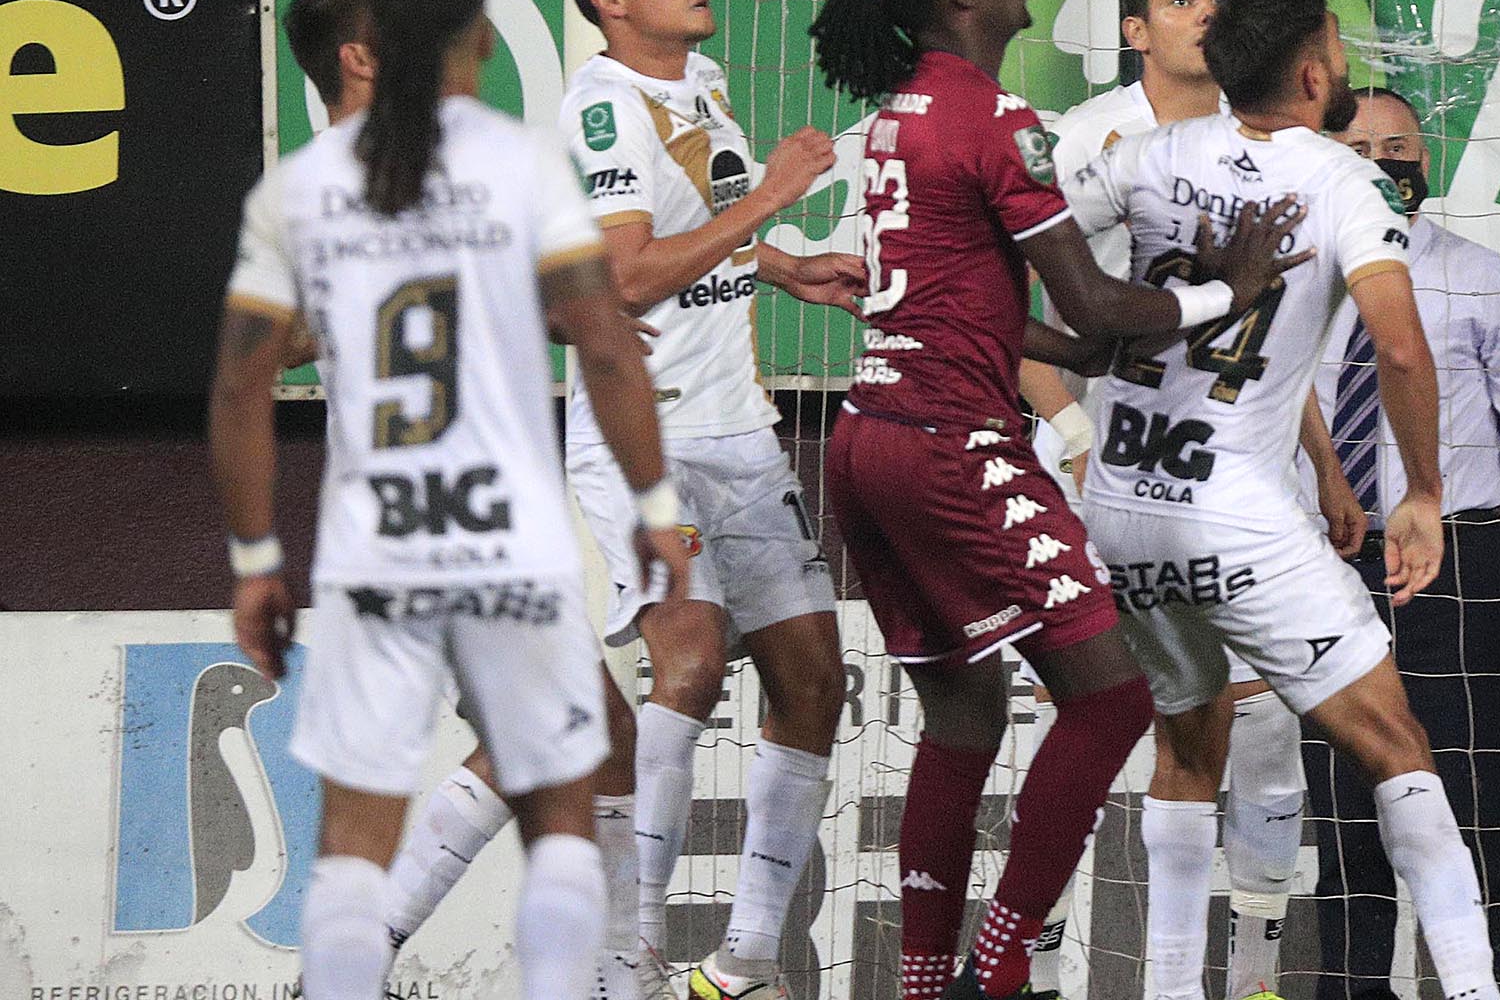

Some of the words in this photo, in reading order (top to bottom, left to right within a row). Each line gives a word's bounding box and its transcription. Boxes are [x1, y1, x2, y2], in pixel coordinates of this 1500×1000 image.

[374, 271, 462, 451] 9
[1101, 402, 1215, 482] BIG
[368, 465, 514, 539] BIG
[1133, 479, 1194, 505] COLA
[963, 605, 1023, 639] Kappa
